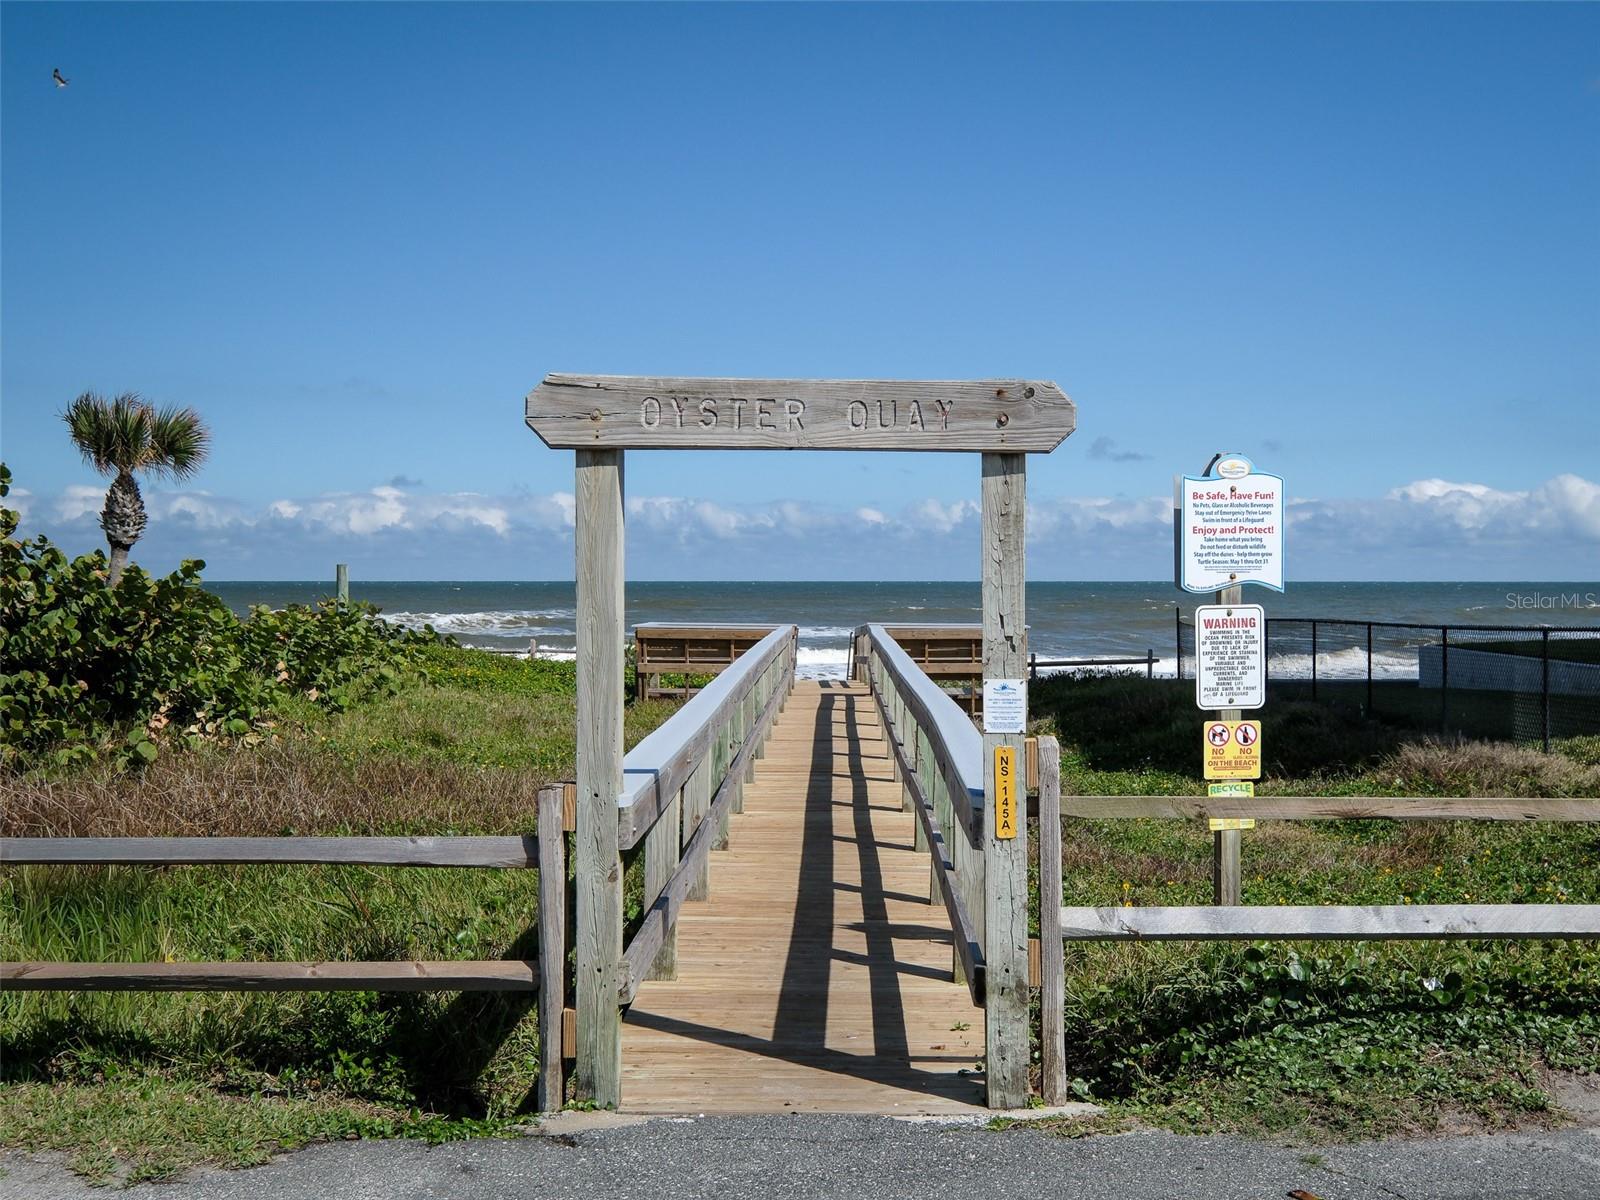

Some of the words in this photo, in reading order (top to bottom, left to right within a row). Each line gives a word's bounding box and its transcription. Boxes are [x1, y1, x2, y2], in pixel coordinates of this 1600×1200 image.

[640, 396, 807, 432] OYSTER
[847, 399, 954, 432] QUAY
[1192, 491, 1204, 500] Be
[1206, 491, 1228, 501] Safe,
[1230, 491, 1252, 500] Have
[1254, 491, 1274, 500] Fun!
[1192, 526, 1218, 536] Enjoy
[1219, 526, 1237, 534] and
[1239, 526, 1274, 534] Protect!
[1204, 618, 1256, 629] WARNING
[1210, 784, 1251, 794] RECYCLE
